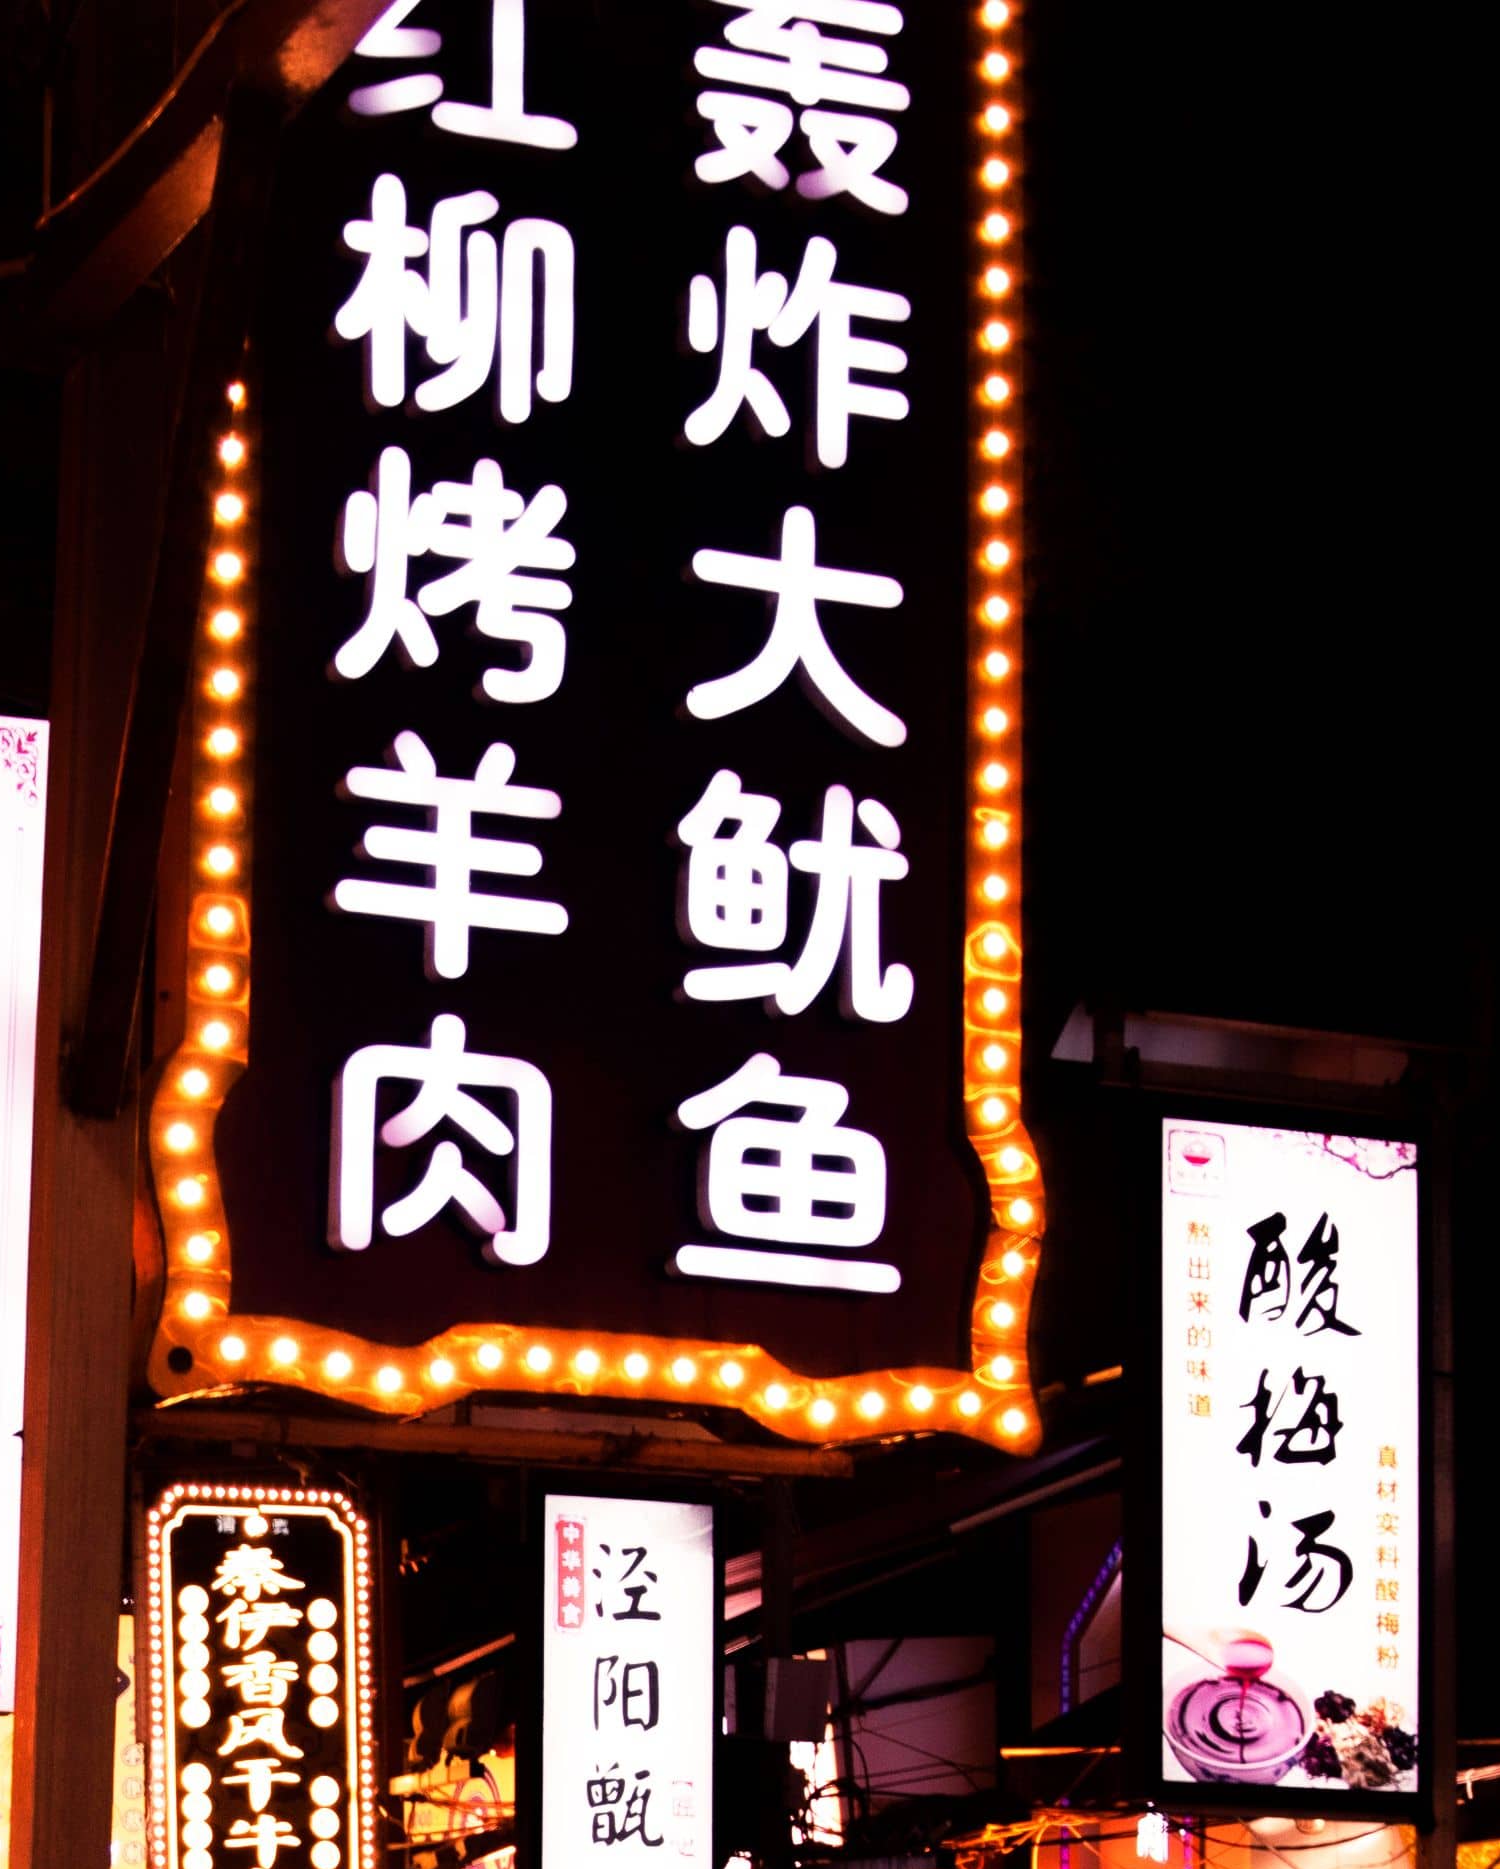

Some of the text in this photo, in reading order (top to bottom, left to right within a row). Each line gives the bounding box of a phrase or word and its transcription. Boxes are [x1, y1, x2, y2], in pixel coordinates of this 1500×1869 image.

[675, 0, 914, 1293] 轰炸大鱿鱼
[1235, 1211, 1362, 1613] 酸梅汤
